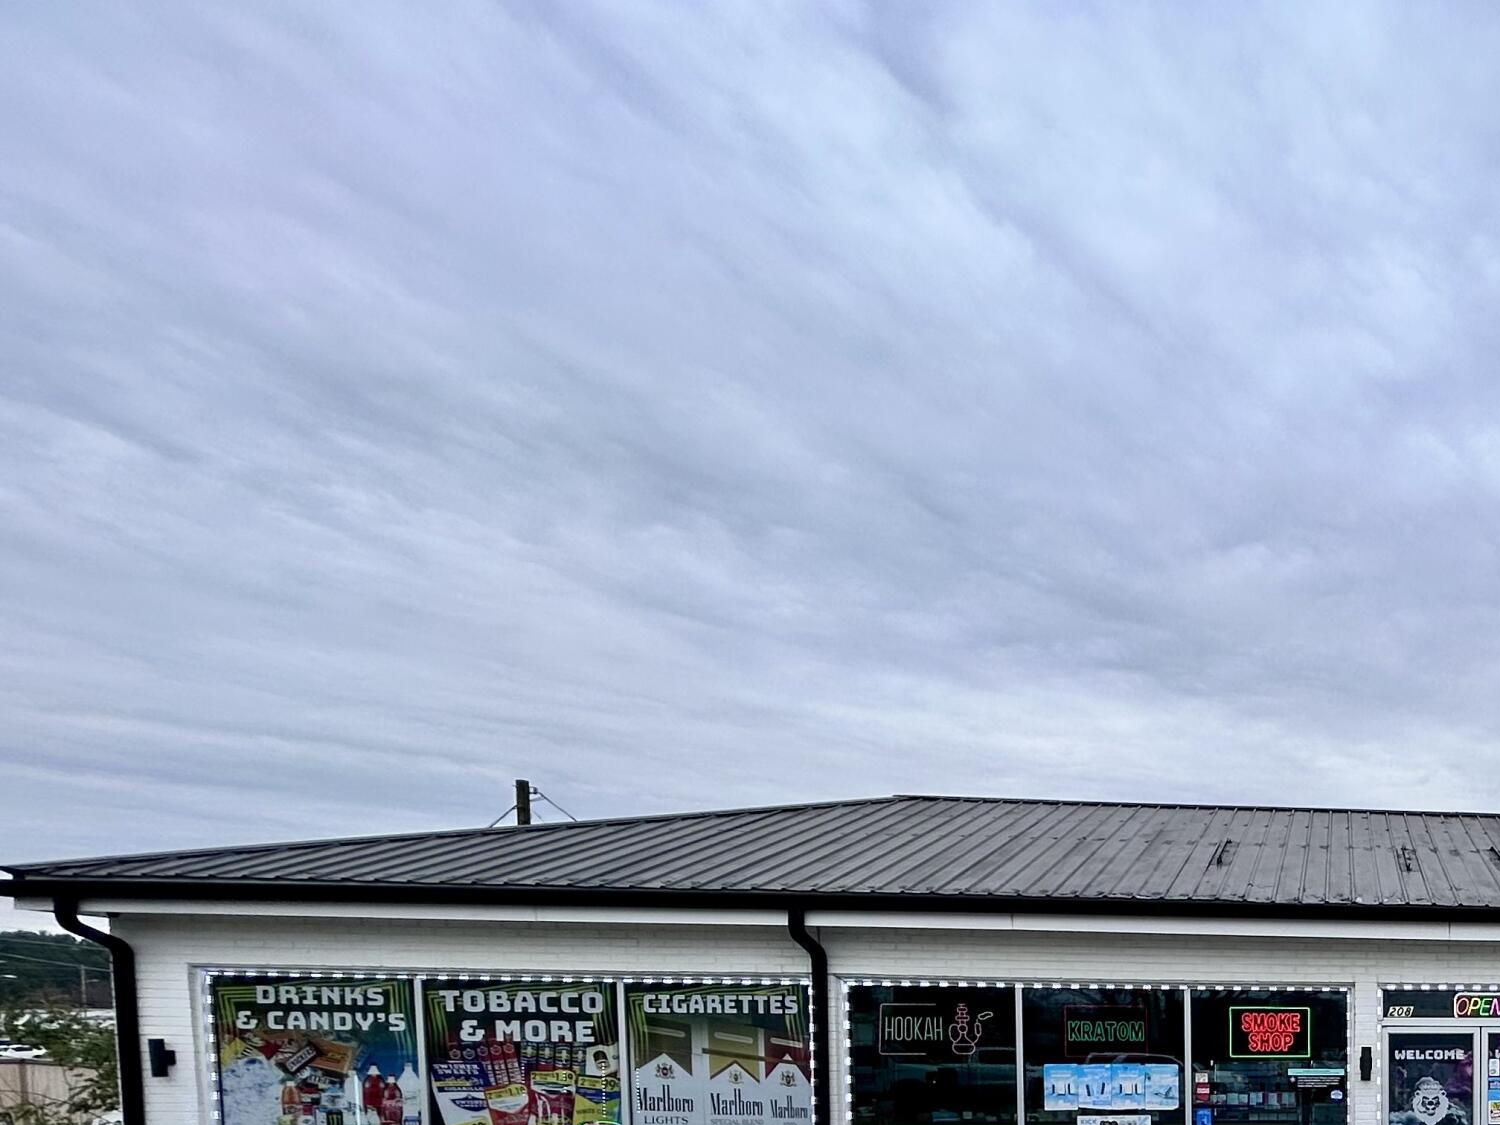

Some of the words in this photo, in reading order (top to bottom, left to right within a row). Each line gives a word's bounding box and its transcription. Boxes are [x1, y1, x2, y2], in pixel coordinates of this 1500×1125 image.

[255, 985, 385, 1006] DRINKS
[439, 989, 604, 1014] TOBACCO
[642, 993, 798, 1015] CIGARETTES
[235, 1011, 257, 1030] &
[267, 1011, 405, 1032] CANDY'S
[1241, 1012, 1301, 1032] SMOKE
[1389, 1007, 1412, 1017] 208
[459, 1019, 486, 1042] &
[495, 1019, 595, 1043] MORE
[884, 1016, 944, 1041] HOOKAH
[1067, 1020, 1145, 1042] KRATOM
[1248, 1032, 1294, 1052] SHOP
[1394, 1049, 1465, 1060] WELCOME
[638, 1085, 694, 1113] Marlboro
[710, 1088, 764, 1116] Marlboro
[769, 1095, 808, 1119] Marlboro
[644, 1116, 689, 1125] LIGHTS
